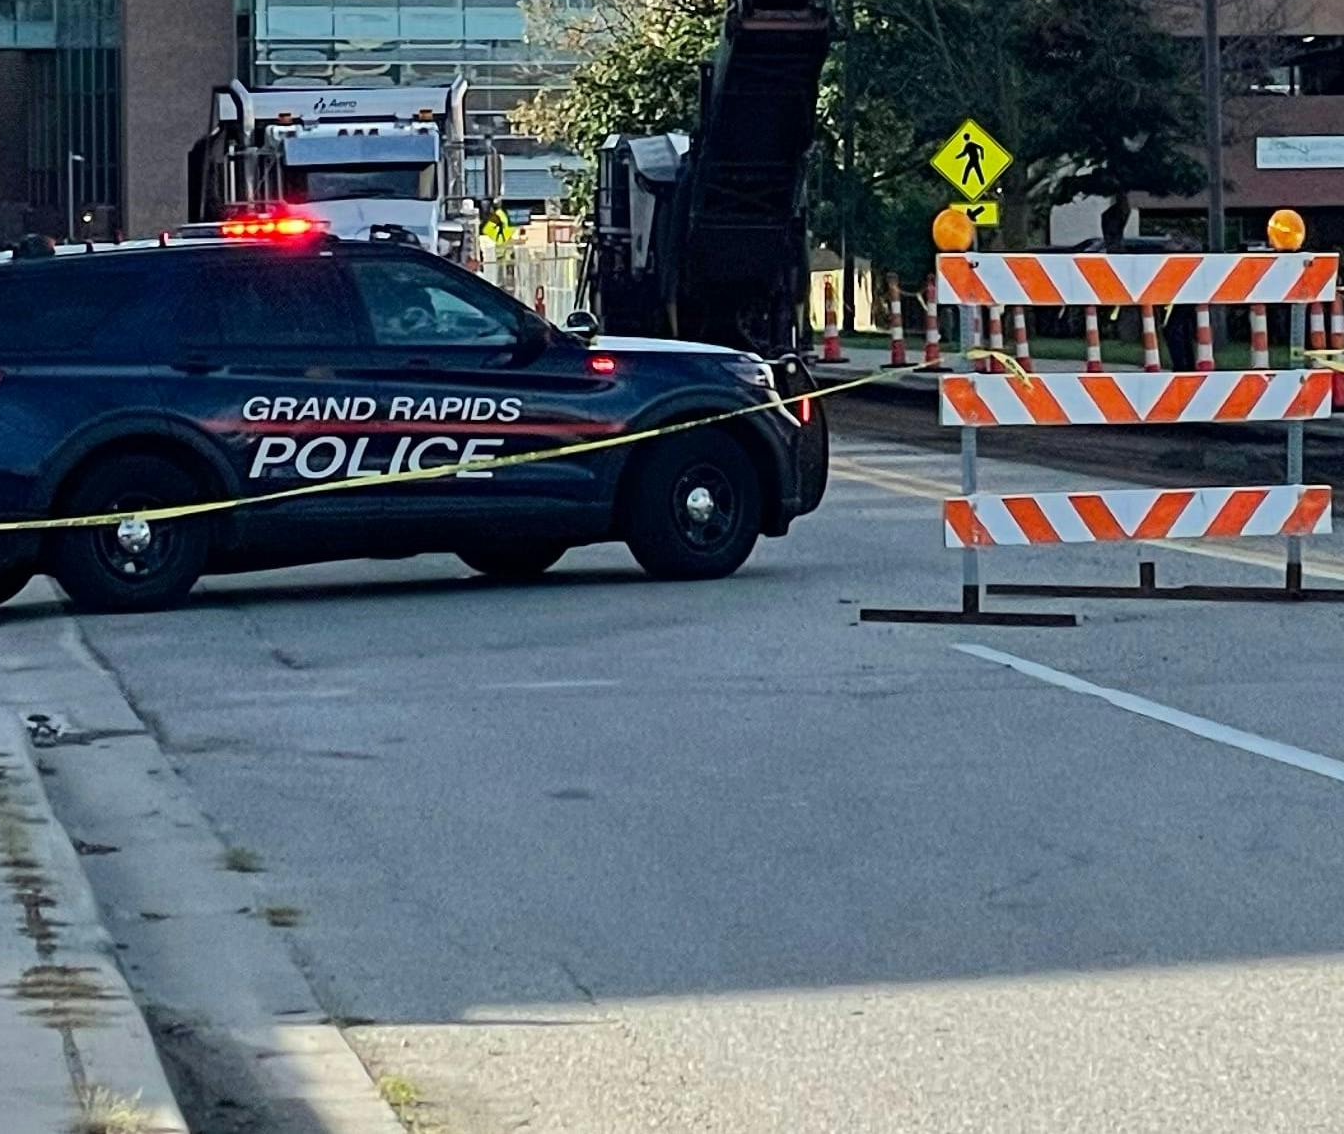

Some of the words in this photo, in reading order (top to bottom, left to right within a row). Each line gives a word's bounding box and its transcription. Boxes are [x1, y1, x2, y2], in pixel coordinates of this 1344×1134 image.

[242, 396, 377, 421] GRAND
[389, 396, 523, 422] RAPIDS
[248, 435, 505, 479] POLICE
